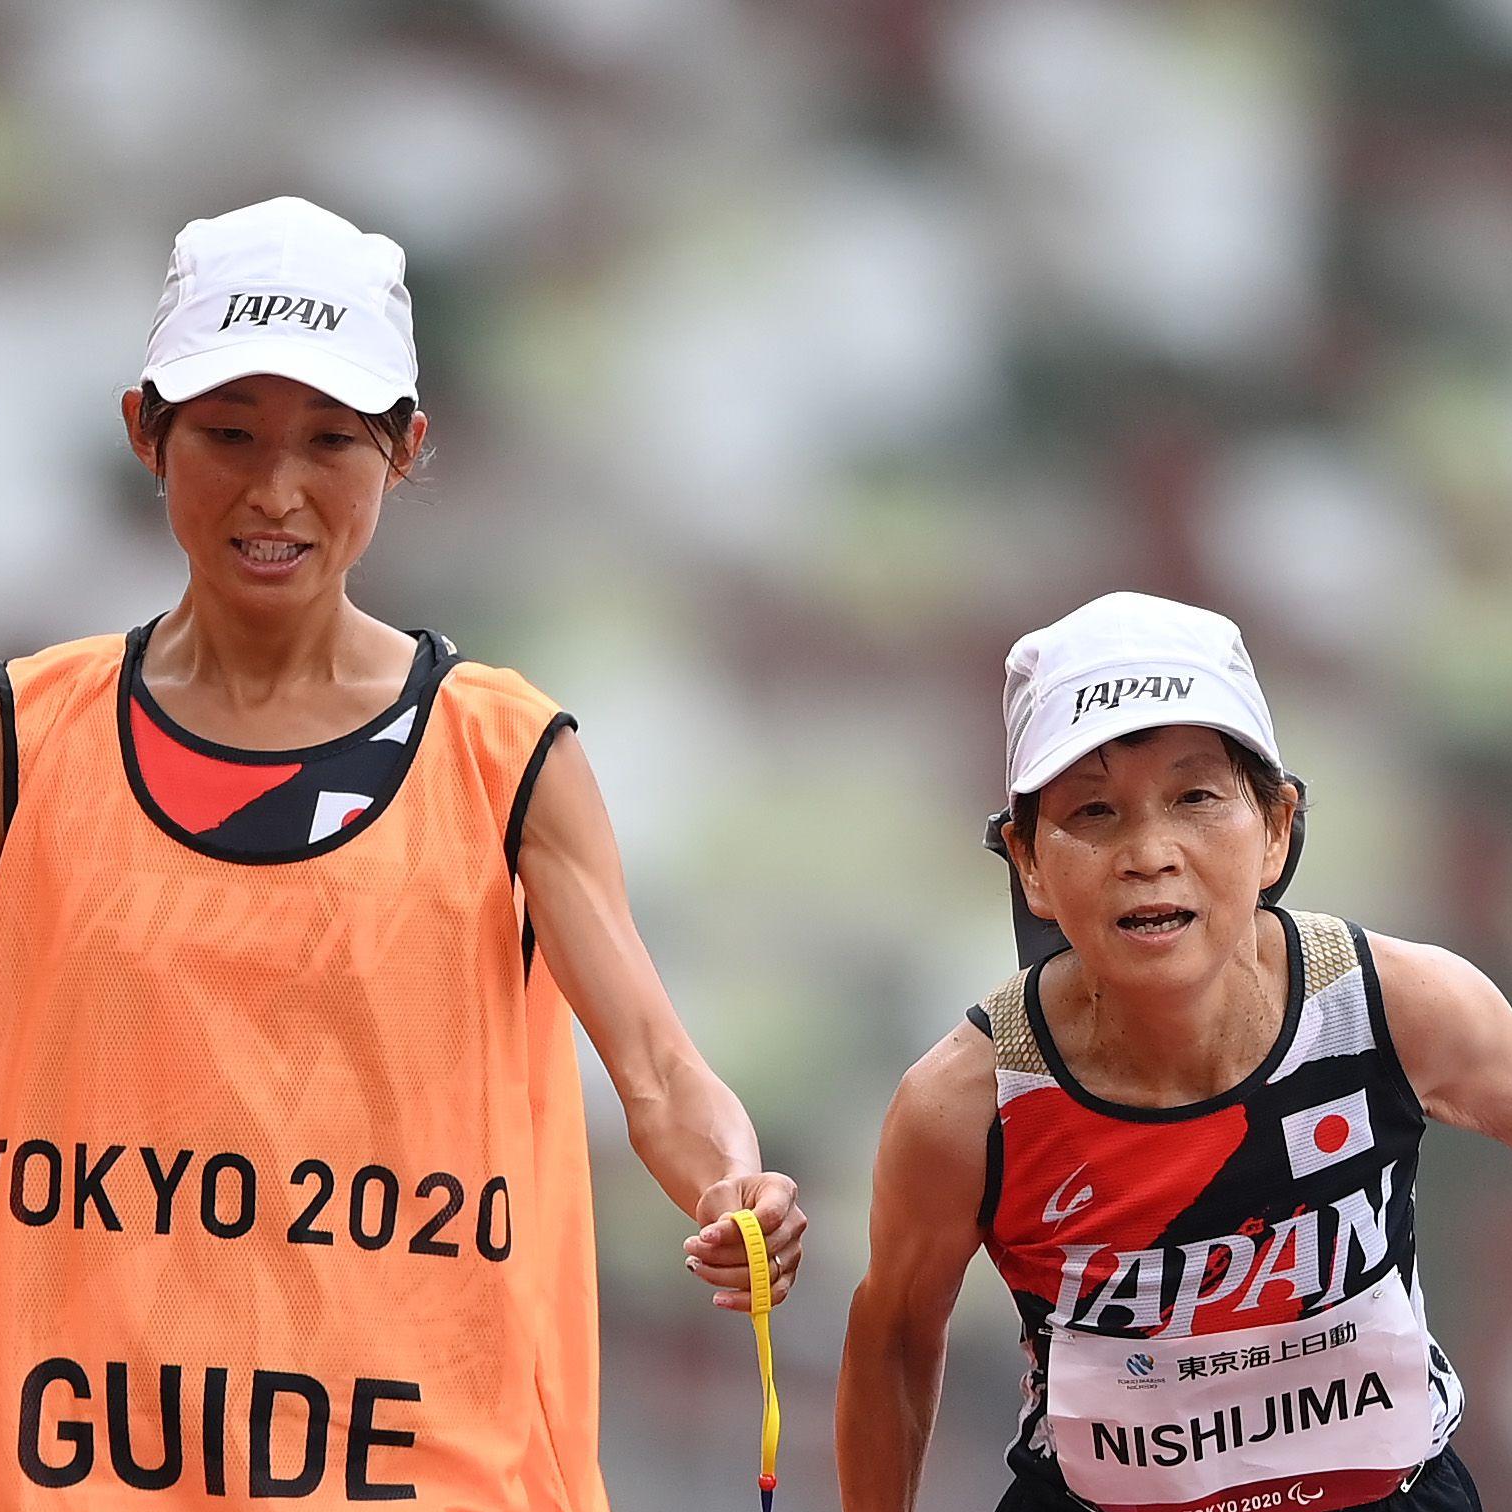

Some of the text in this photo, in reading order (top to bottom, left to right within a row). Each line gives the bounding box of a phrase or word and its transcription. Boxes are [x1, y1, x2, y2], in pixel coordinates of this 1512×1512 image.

[218, 293, 348, 331] JAPAN
[1071, 676, 1194, 724] JAPAN
[286, 1158, 513, 1263] 2020
[1045, 1159, 1399, 1340] JAPAN
[1176, 1320, 1357, 1382] 東京海上日動
[16, 1356, 423, 1501] GUIDE
[1091, 1371, 1393, 1468] NISHIJIMA
[1241, 1491, 1282, 1512] 2020
